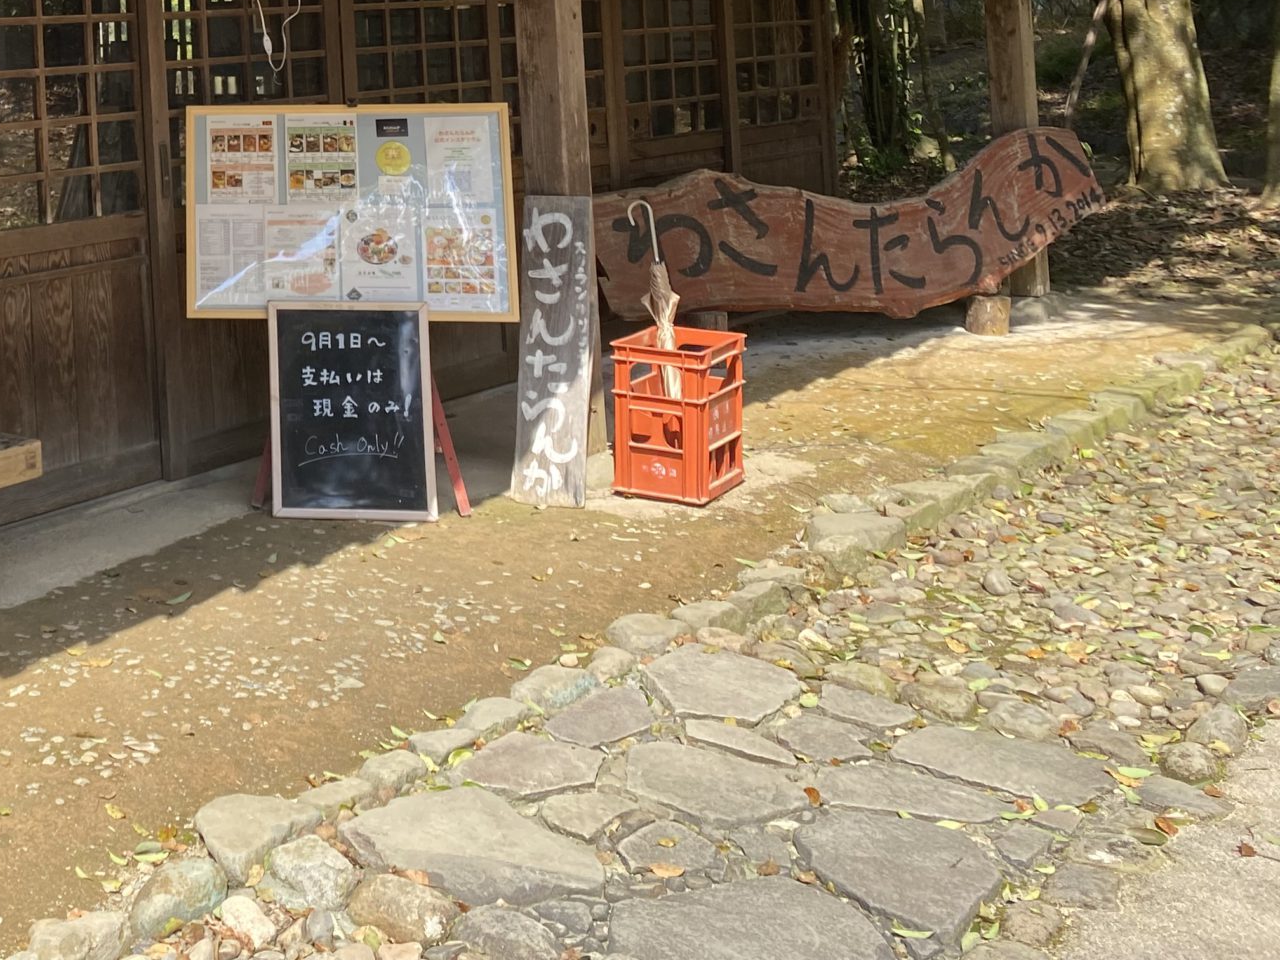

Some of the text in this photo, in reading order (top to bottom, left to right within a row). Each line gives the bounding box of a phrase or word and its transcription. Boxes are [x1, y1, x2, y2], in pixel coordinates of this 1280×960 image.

[612, 133, 1092, 295] わさんたらんか
[301, 366, 384, 387] 支払いは
[521, 206, 578, 497] わさんたらんか
[304, 433, 349, 456] Cash
